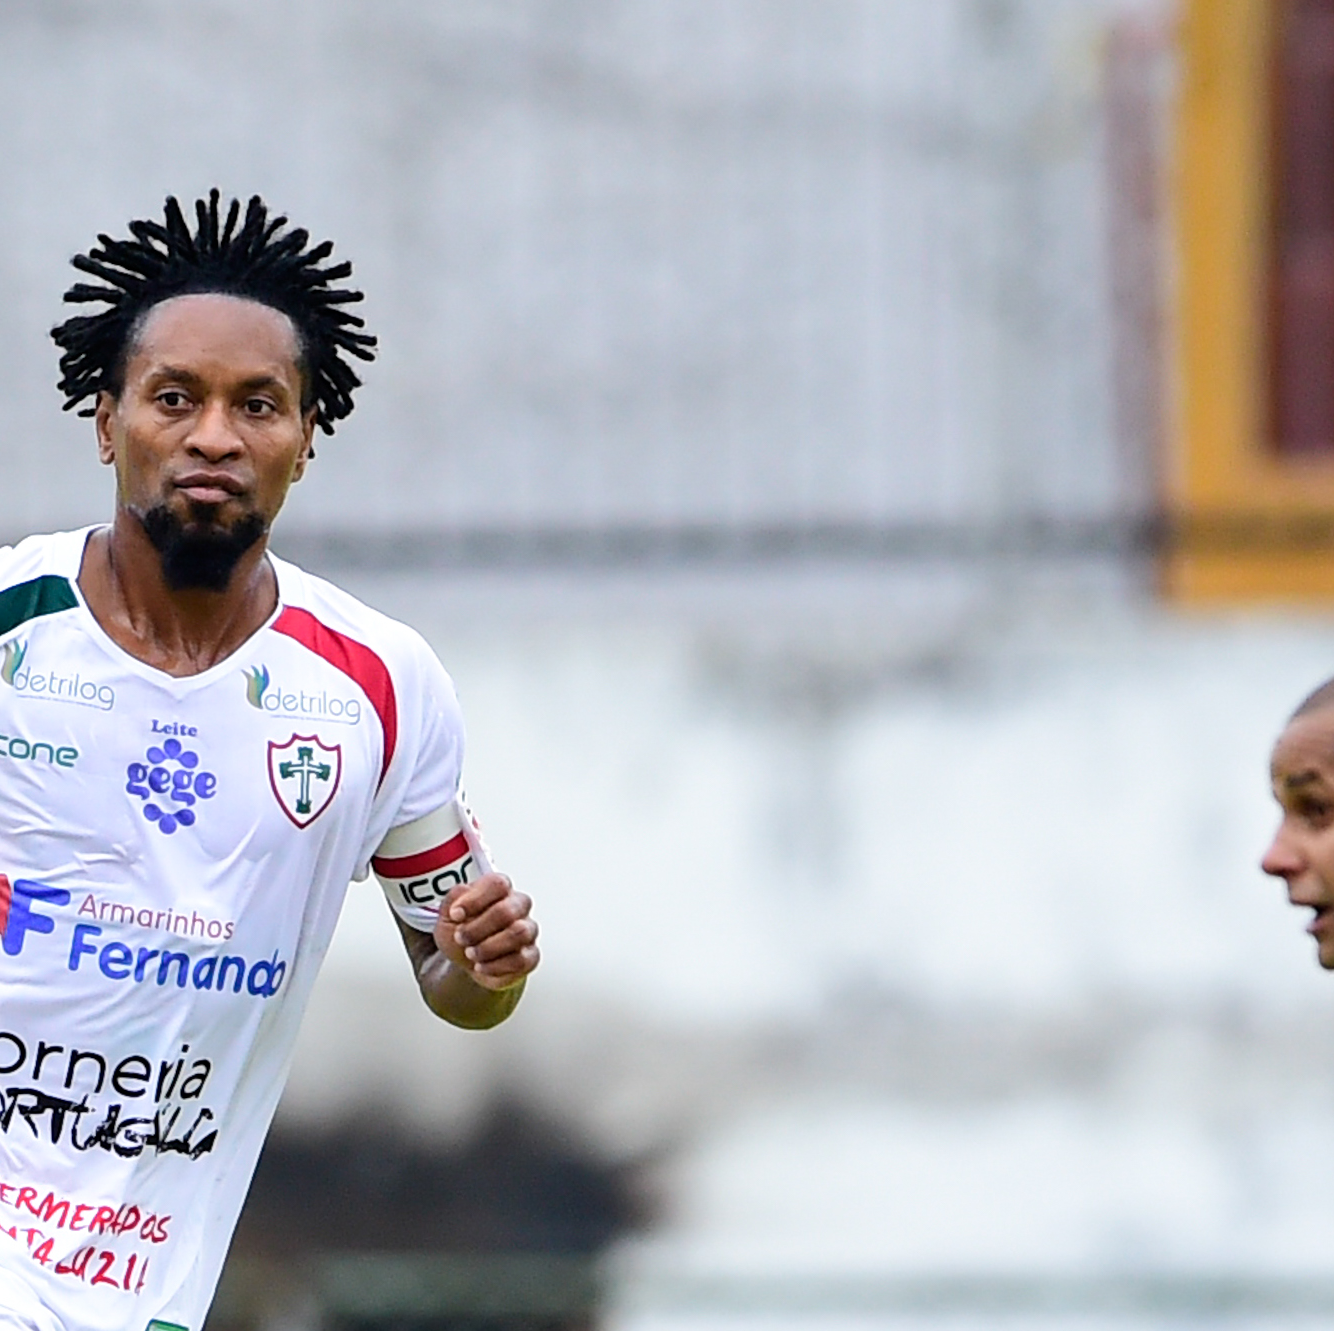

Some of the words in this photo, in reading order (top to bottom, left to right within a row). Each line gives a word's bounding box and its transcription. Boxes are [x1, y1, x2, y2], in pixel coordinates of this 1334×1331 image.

[14, 666, 115, 711] detrilog
[264, 687, 361, 725] detrilog
[151, 719, 198, 737] Leite
[126, 762, 217, 806] gege
[78, 894, 235, 940] Armarinhos
